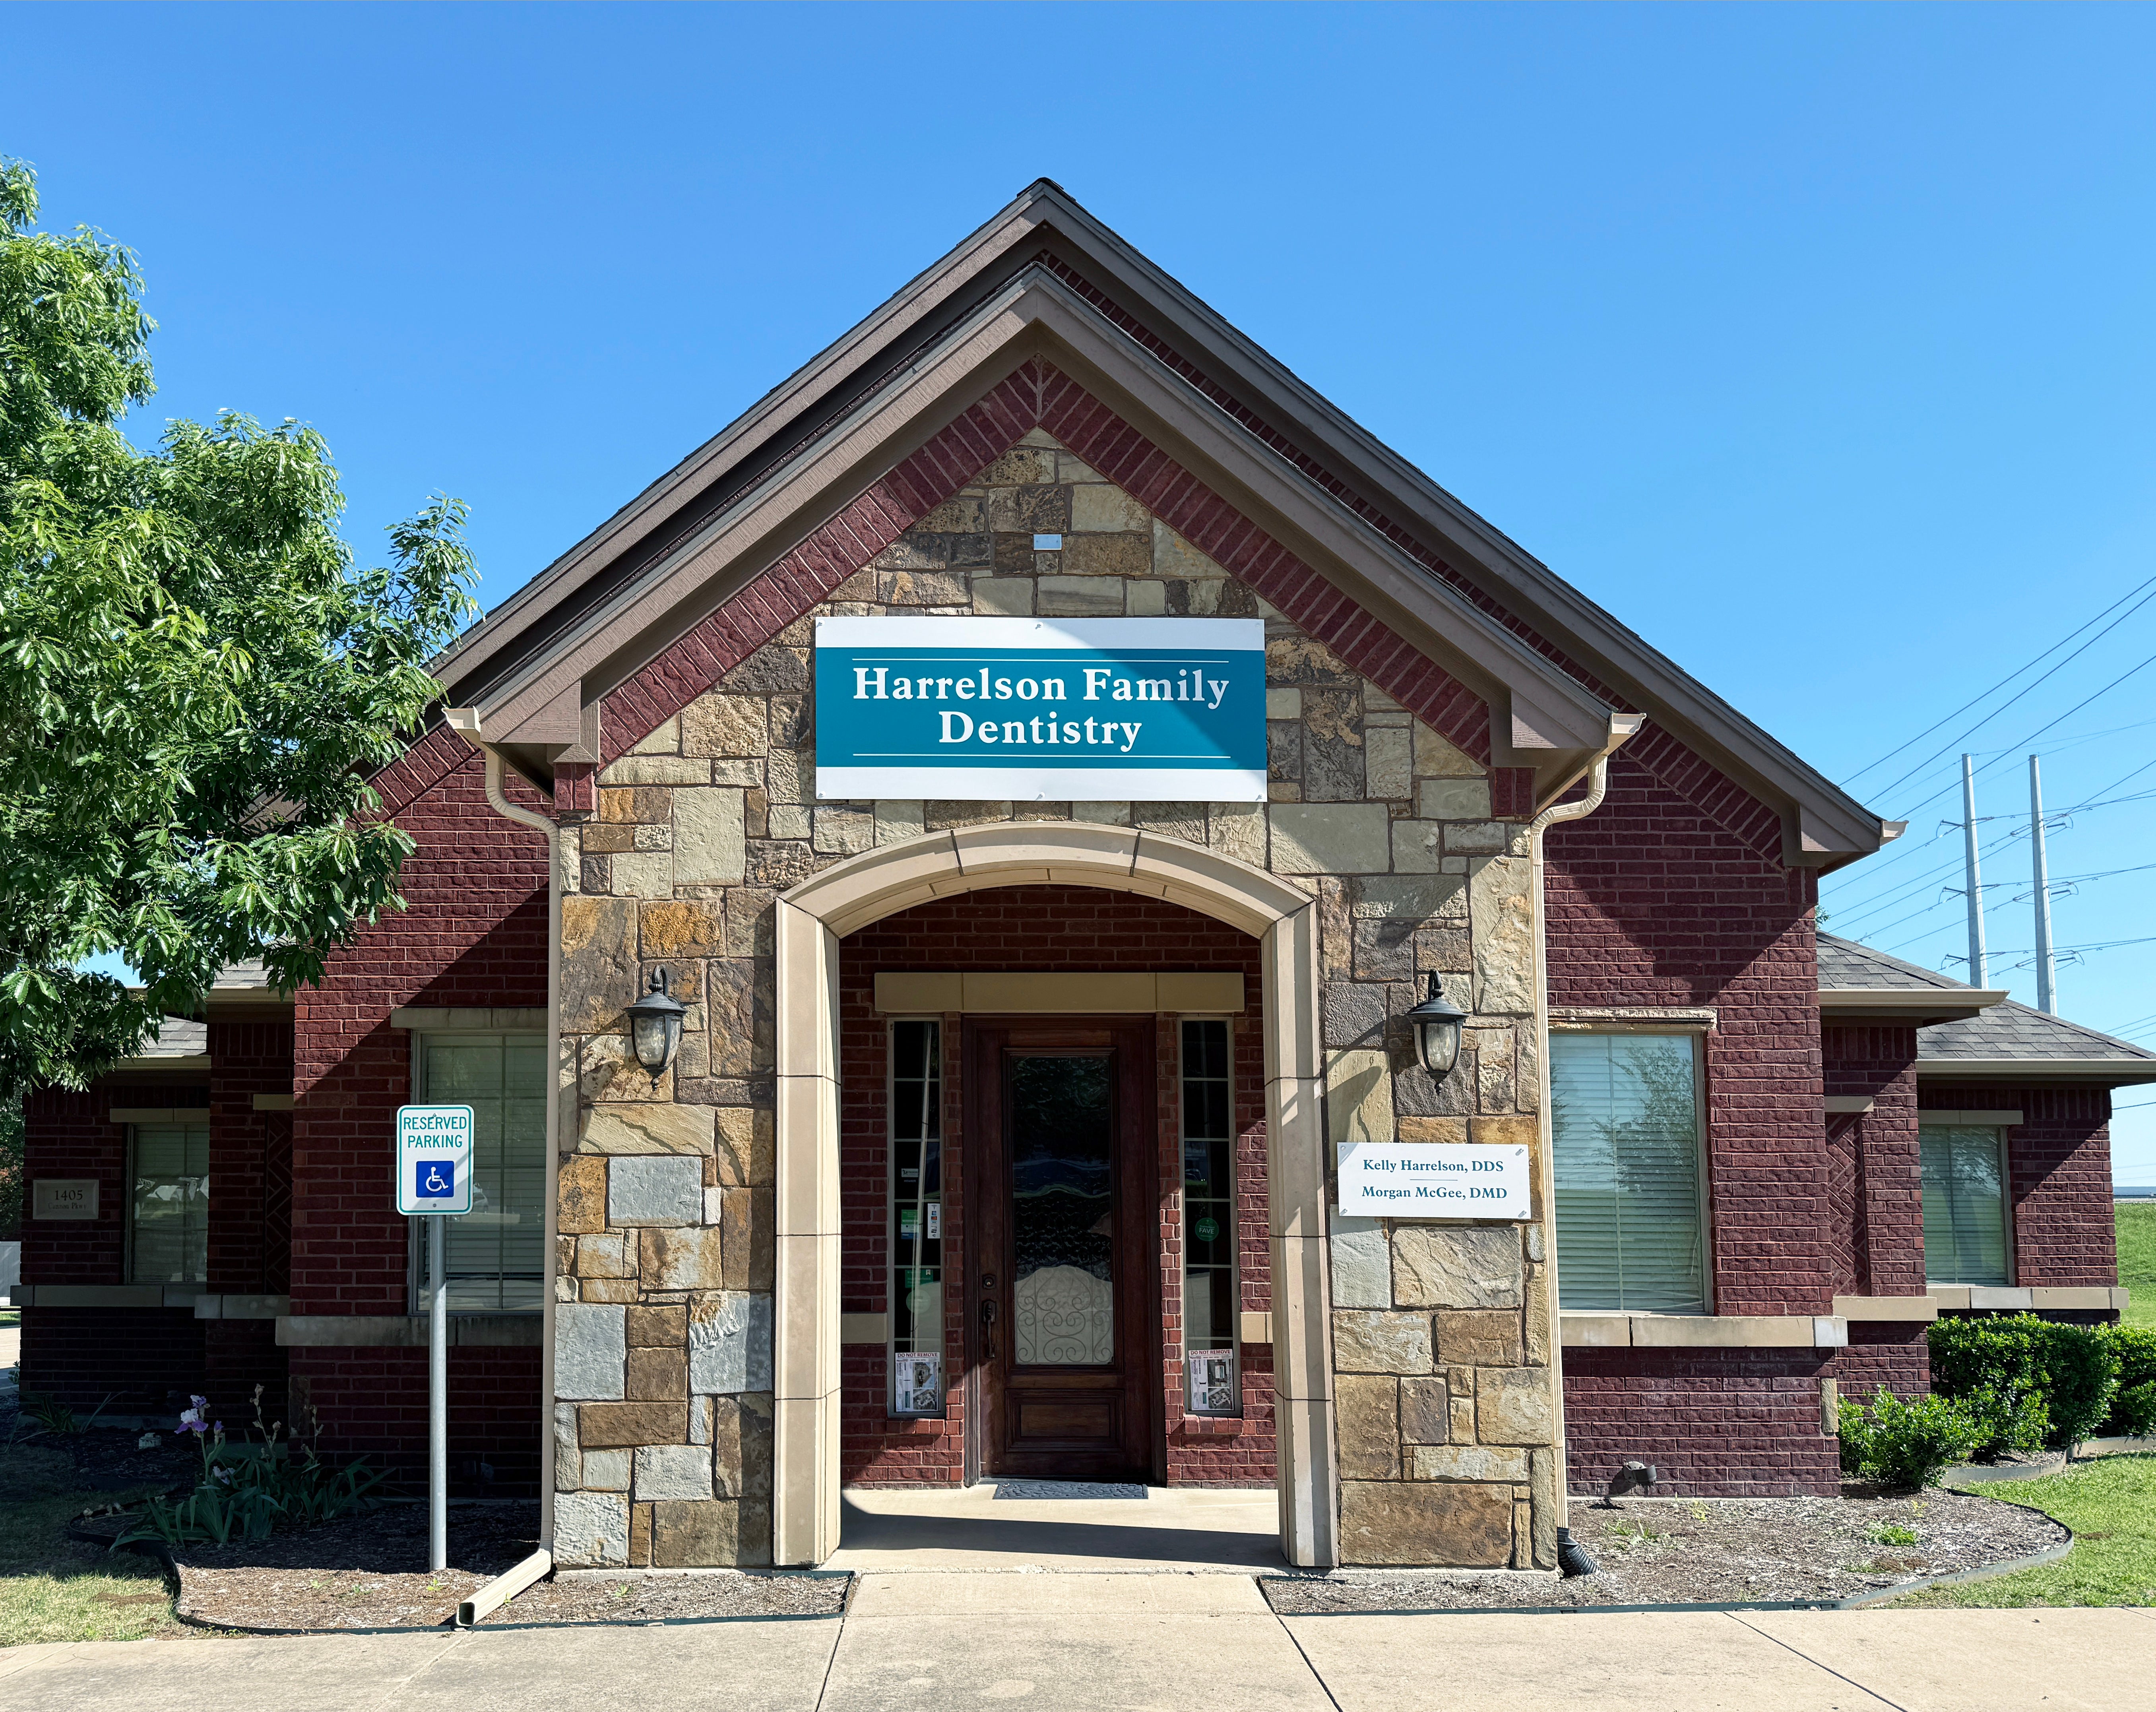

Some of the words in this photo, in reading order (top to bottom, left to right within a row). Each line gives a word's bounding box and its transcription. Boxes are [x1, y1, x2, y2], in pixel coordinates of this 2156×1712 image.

[853, 667, 1067, 701] Harrelson
[1083, 668, 1229, 710] Family
[938, 711, 1142, 752] Dentistry
[403, 1117, 467, 1130] RESERVED
[408, 1135, 462, 1148] PARKING
[1363, 1159, 1397, 1172] Kelly
[1401, 1160, 1468, 1173] Harrelson,
[1472, 1161, 1504, 1171] DDS
[55, 1190, 83, 1201] 1405
[1362, 1186, 1411, 1199] Morgan
[1416, 1187, 1466, 1200] McGee,
[1470, 1187, 1507, 1198] DMD
